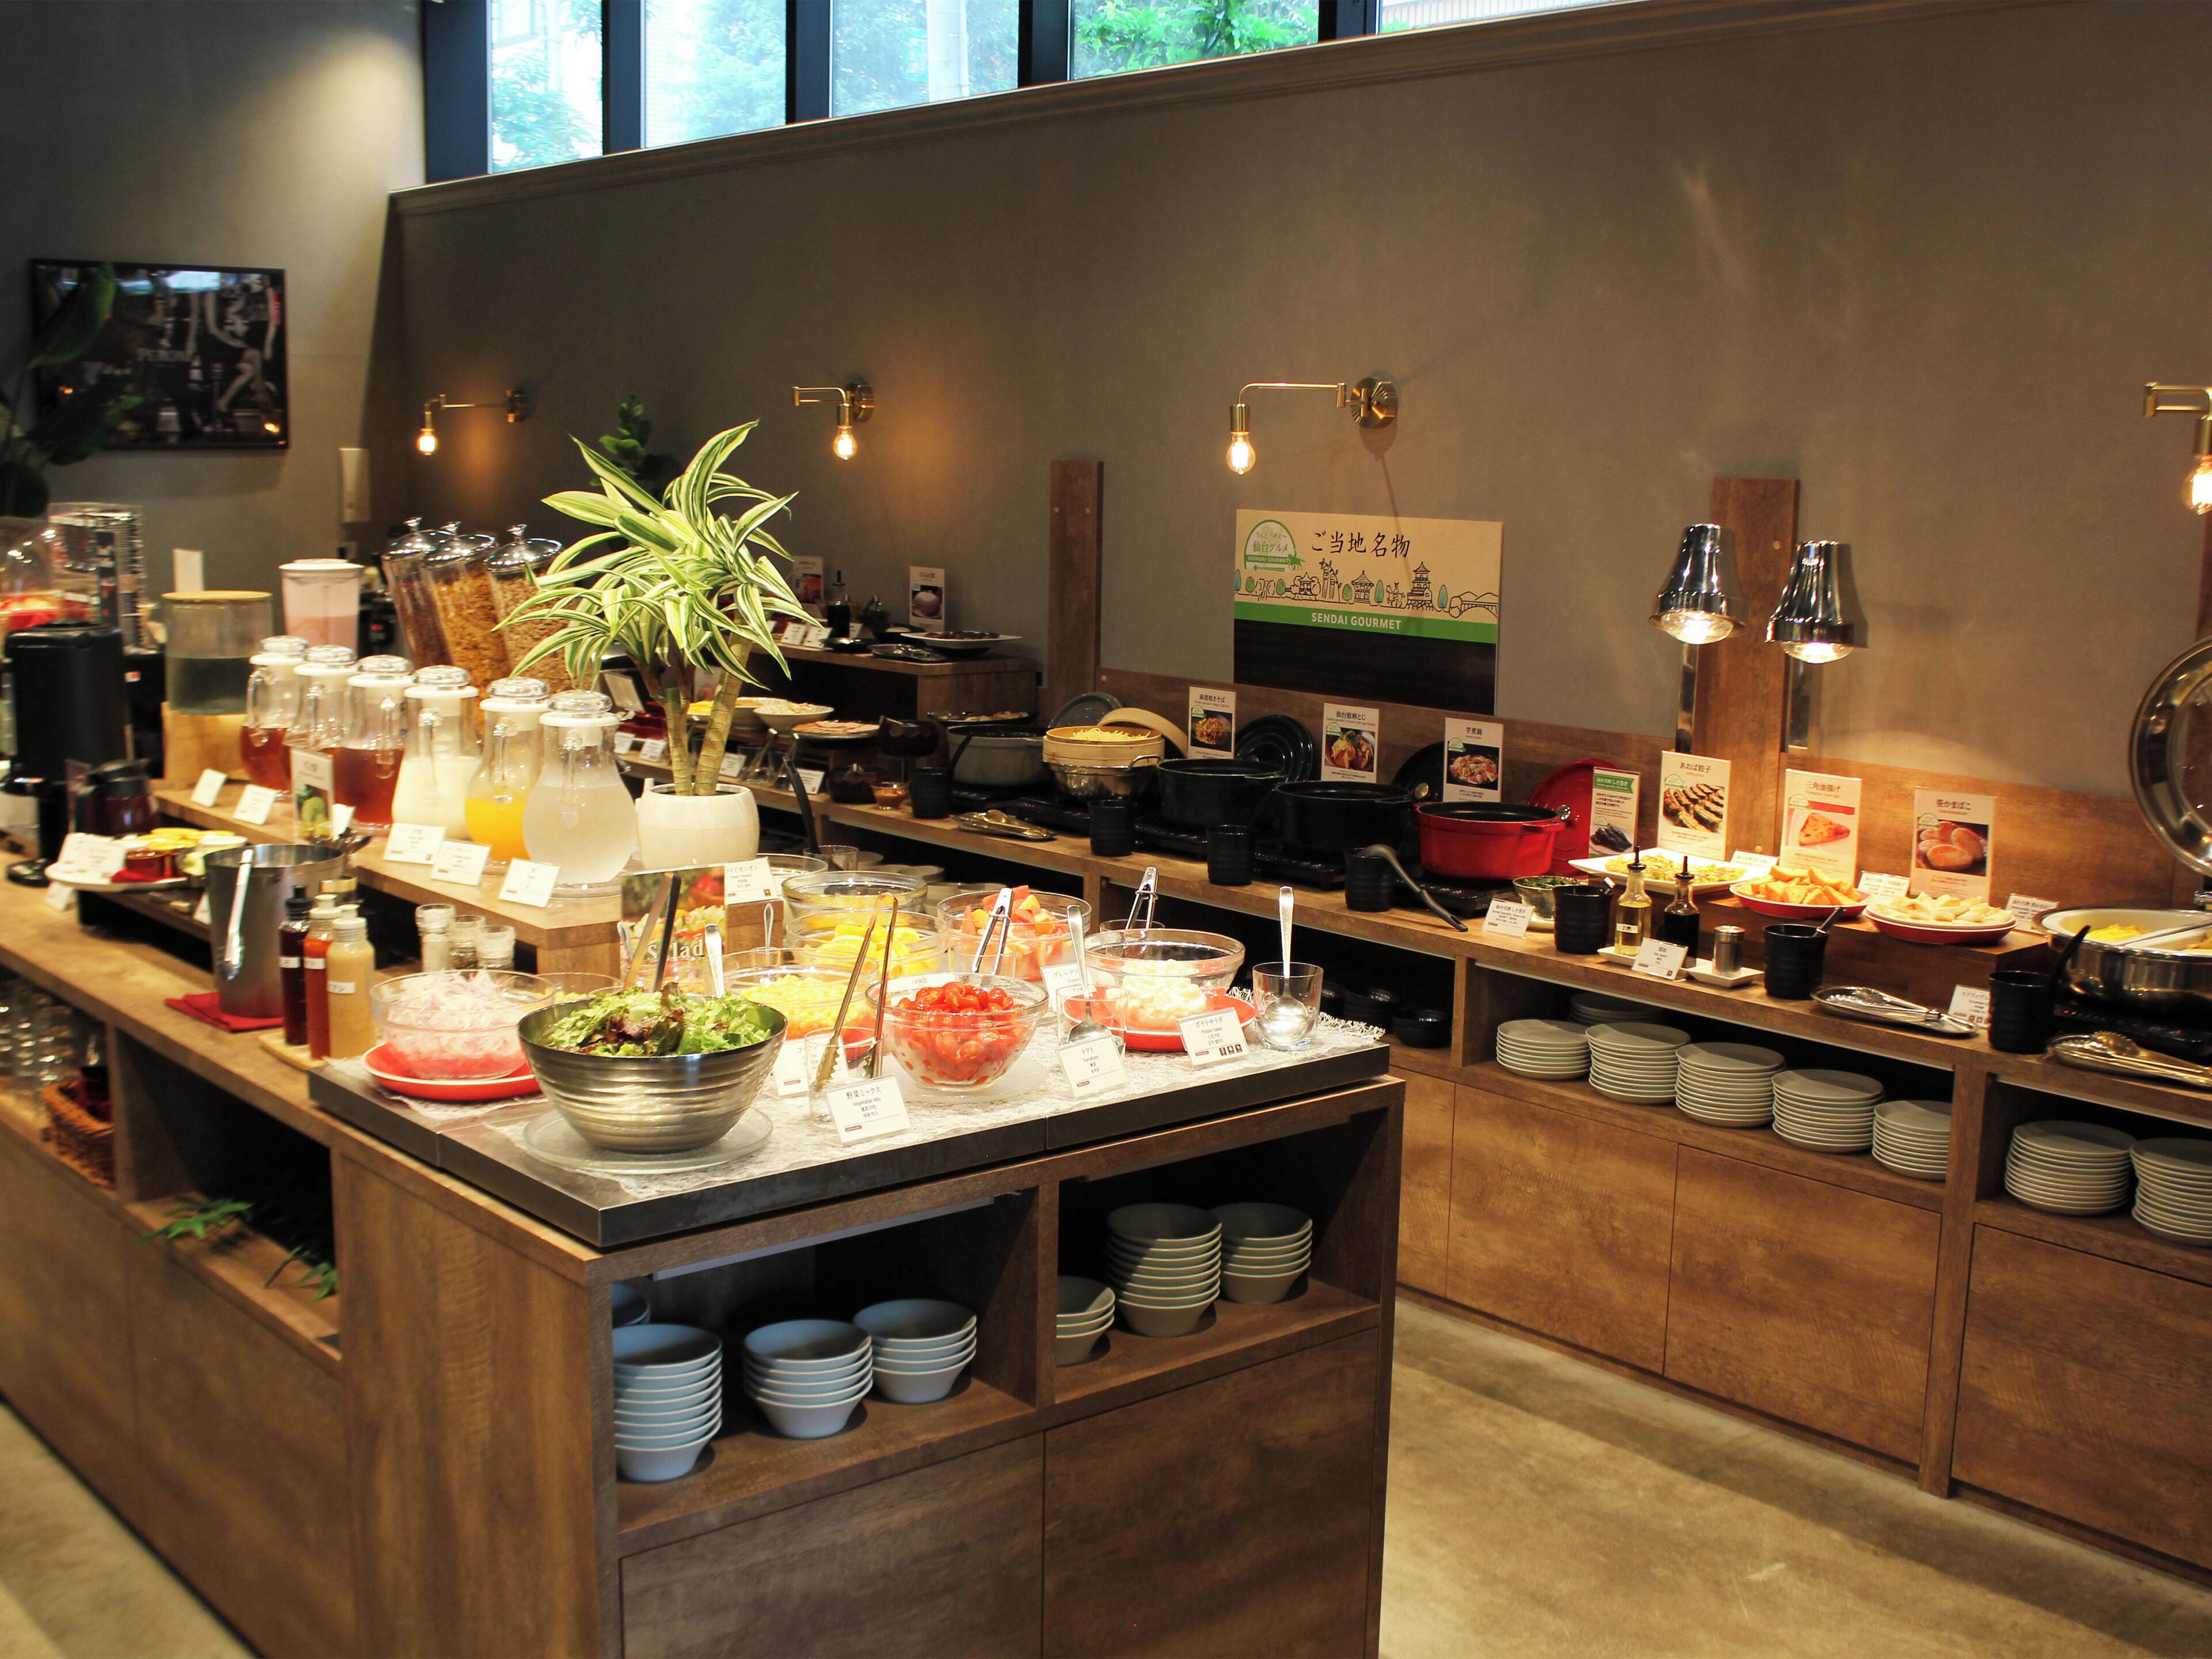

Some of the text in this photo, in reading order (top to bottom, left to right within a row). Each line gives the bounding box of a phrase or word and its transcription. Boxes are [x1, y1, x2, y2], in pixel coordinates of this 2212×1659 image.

[1253, 541, 1288, 553] 仙台グルメ
[1312, 531, 1411, 558] ご当地名物
[1311, 612, 1402, 630] SENDAI GOURMET
[1679, 762, 1711, 773] あおば餃子
[646, 938, 705, 961] Slad
[1195, 1016, 1224, 1028] ポテトサラダ
[1081, 1046, 1094, 1055] トマト
[846, 1086, 882, 1100] 野菜ミックス
[851, 1099, 873, 1107] Vegetable
